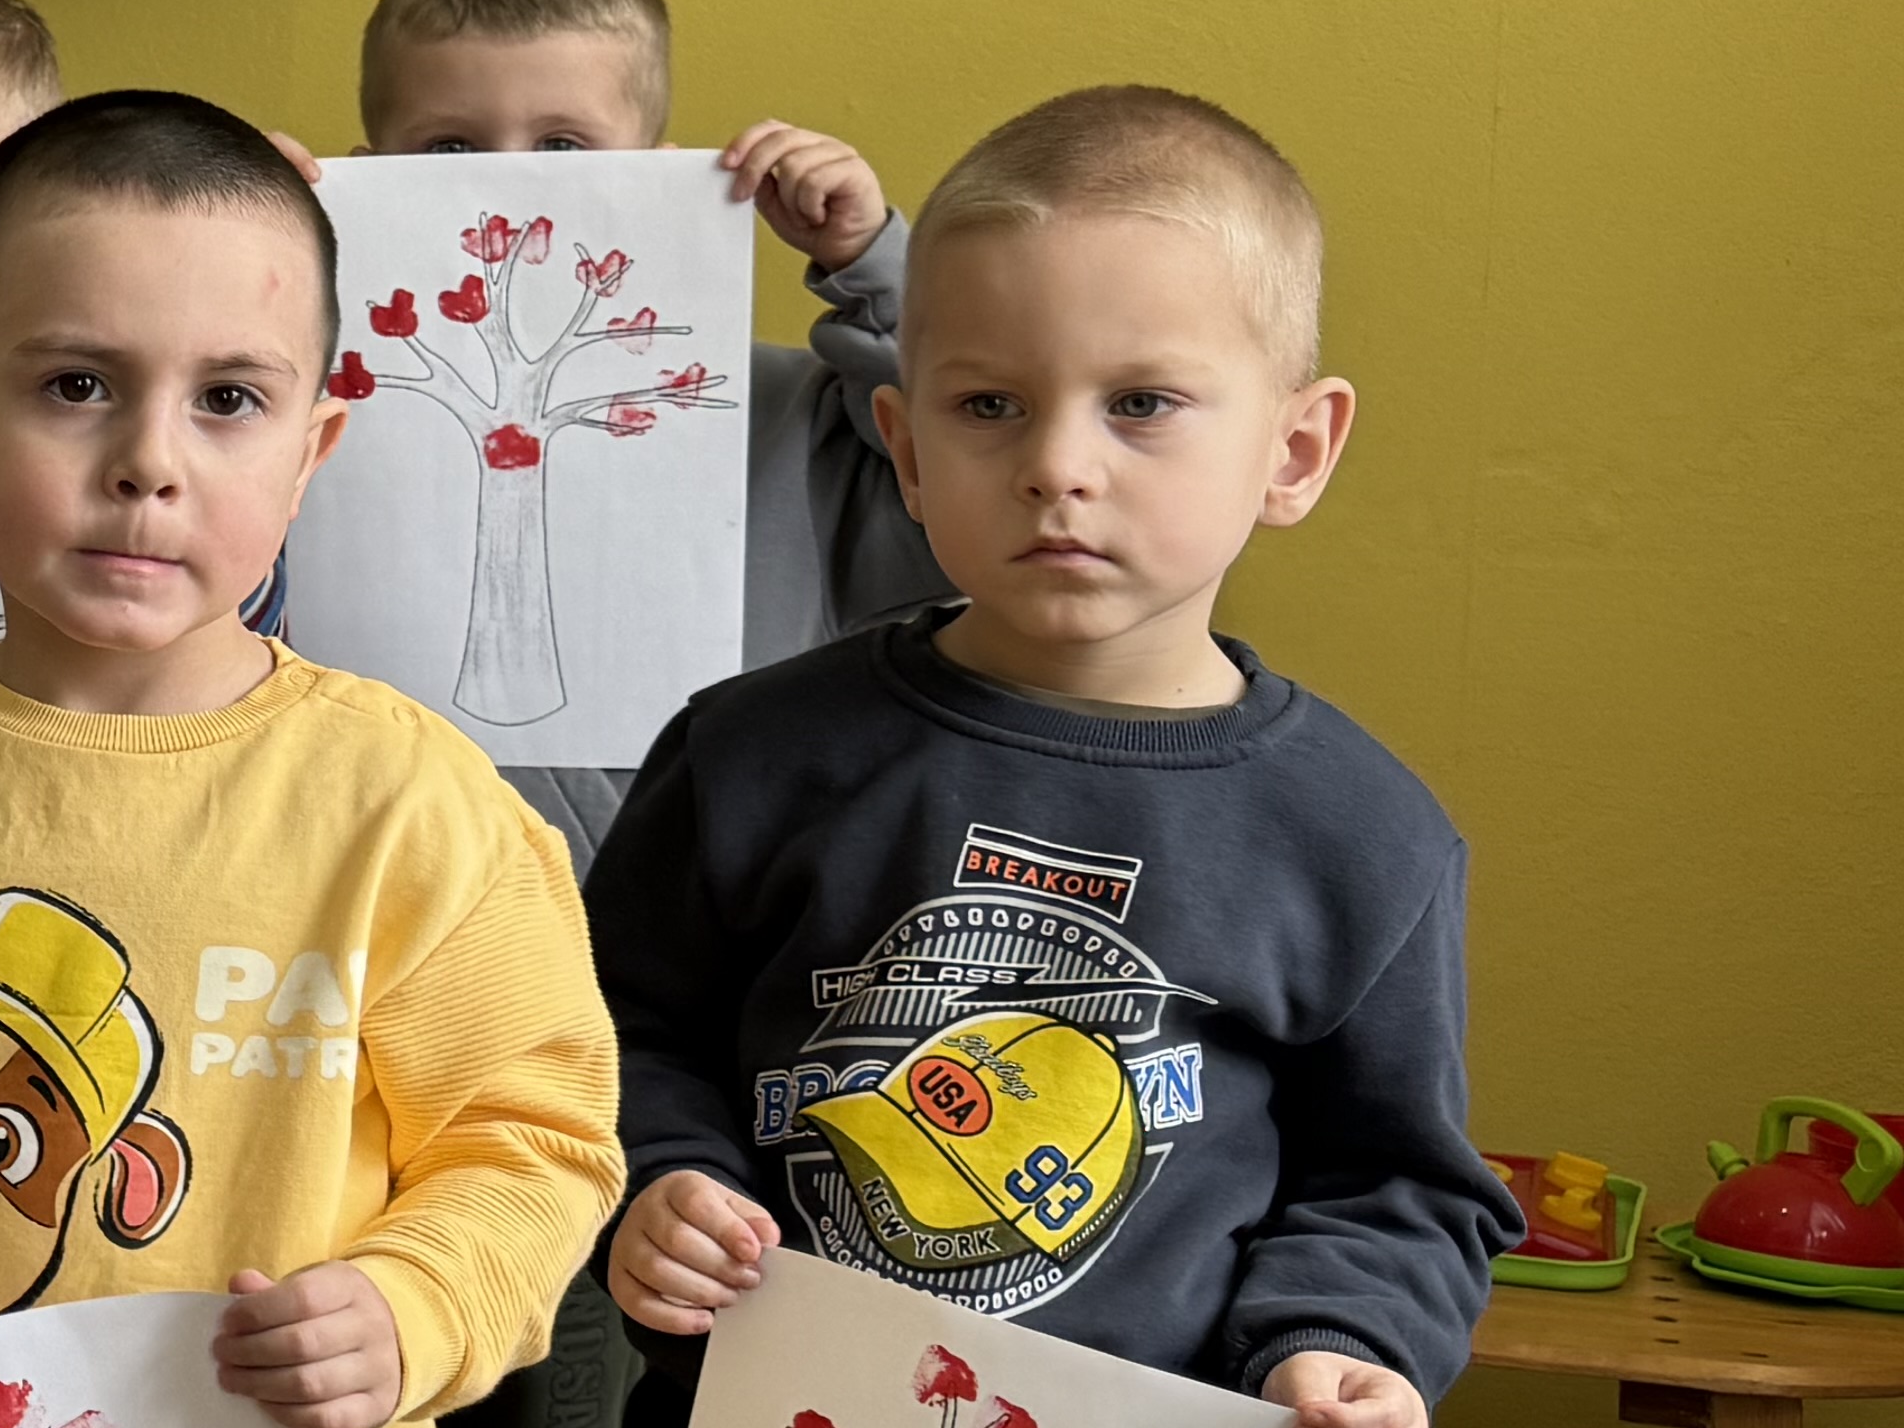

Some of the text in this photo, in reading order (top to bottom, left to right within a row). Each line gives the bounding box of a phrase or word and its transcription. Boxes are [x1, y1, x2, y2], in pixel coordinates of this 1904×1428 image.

[965, 849, 1130, 902] BREAKOUT
[886, 963, 1018, 985] CLASS
[918, 1064, 978, 1129] USA
[860, 1175, 912, 1242] NEW
[911, 1225, 1003, 1261] YORK
[1004, 1144, 1094, 1232] 93
